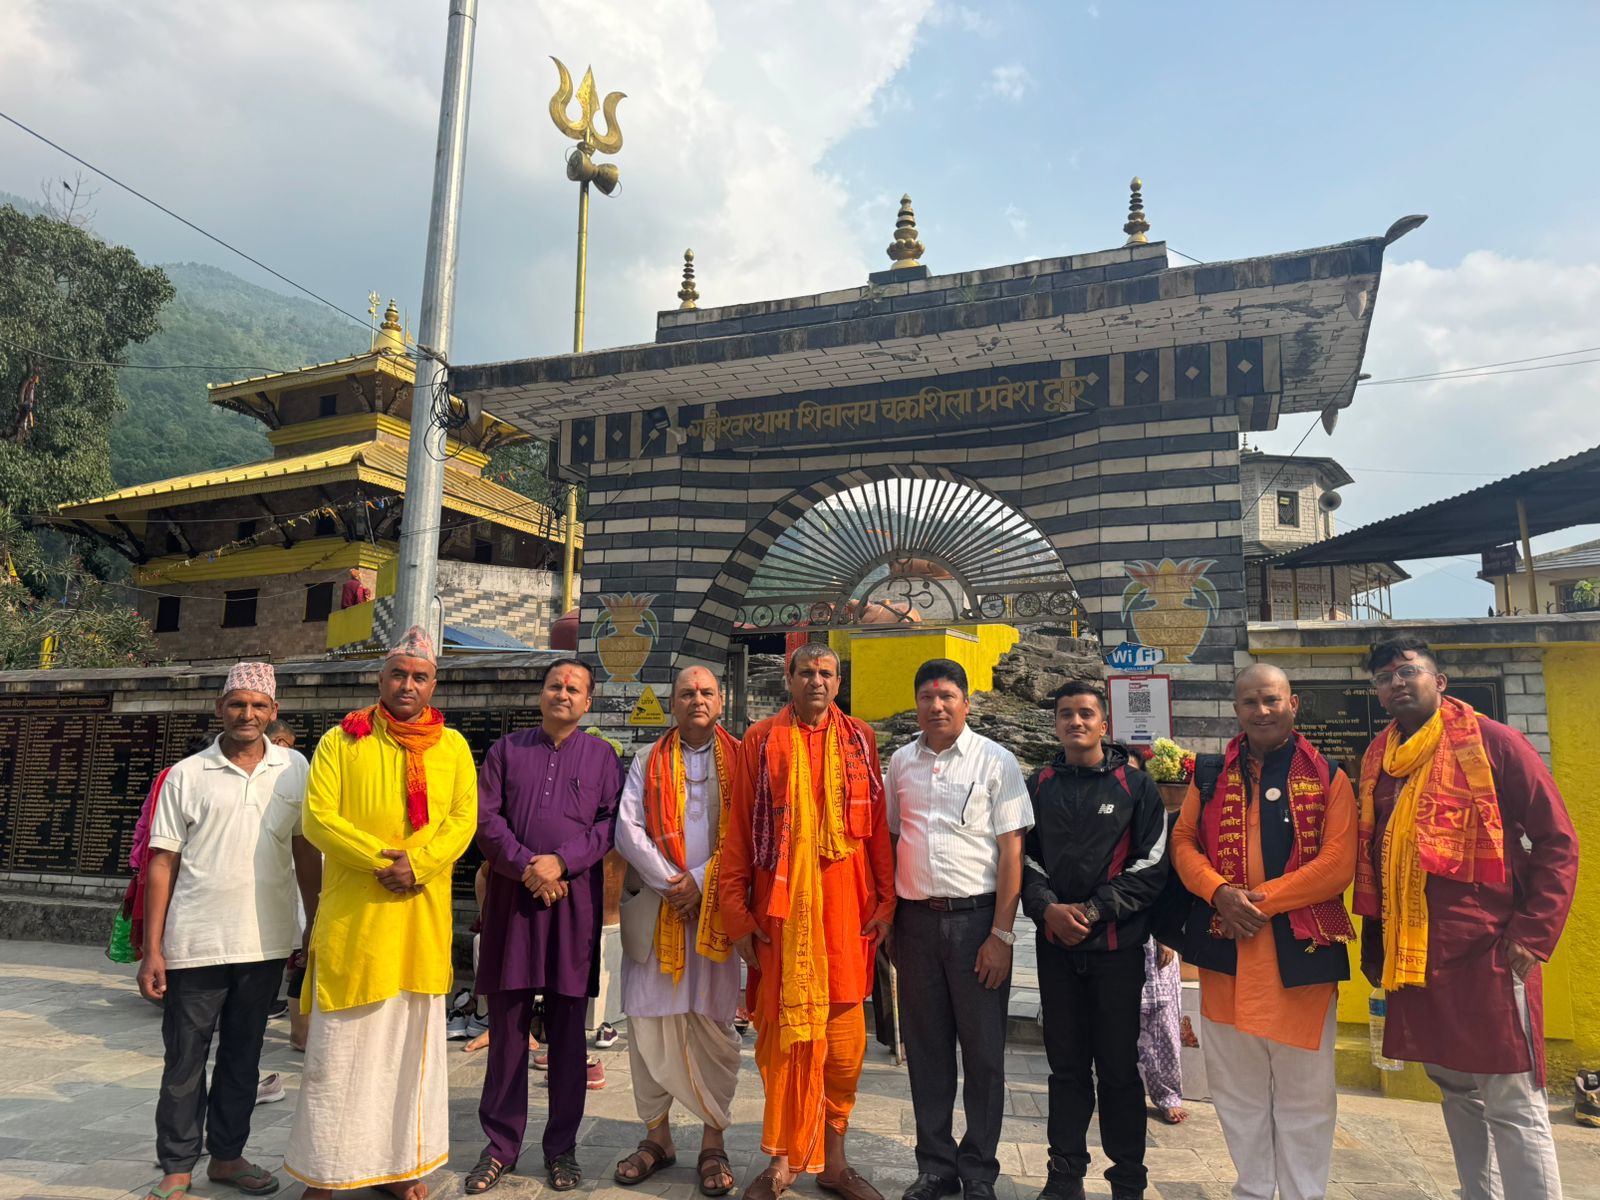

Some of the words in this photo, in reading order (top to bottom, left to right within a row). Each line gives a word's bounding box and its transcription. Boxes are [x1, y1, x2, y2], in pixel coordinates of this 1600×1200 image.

[796, 400, 878, 432] शिवालय
[880, 385, 974, 424] चक्रशिला
[976, 376, 1040, 413] प्रवेश
[1041, 376, 1096, 412] द्वार
